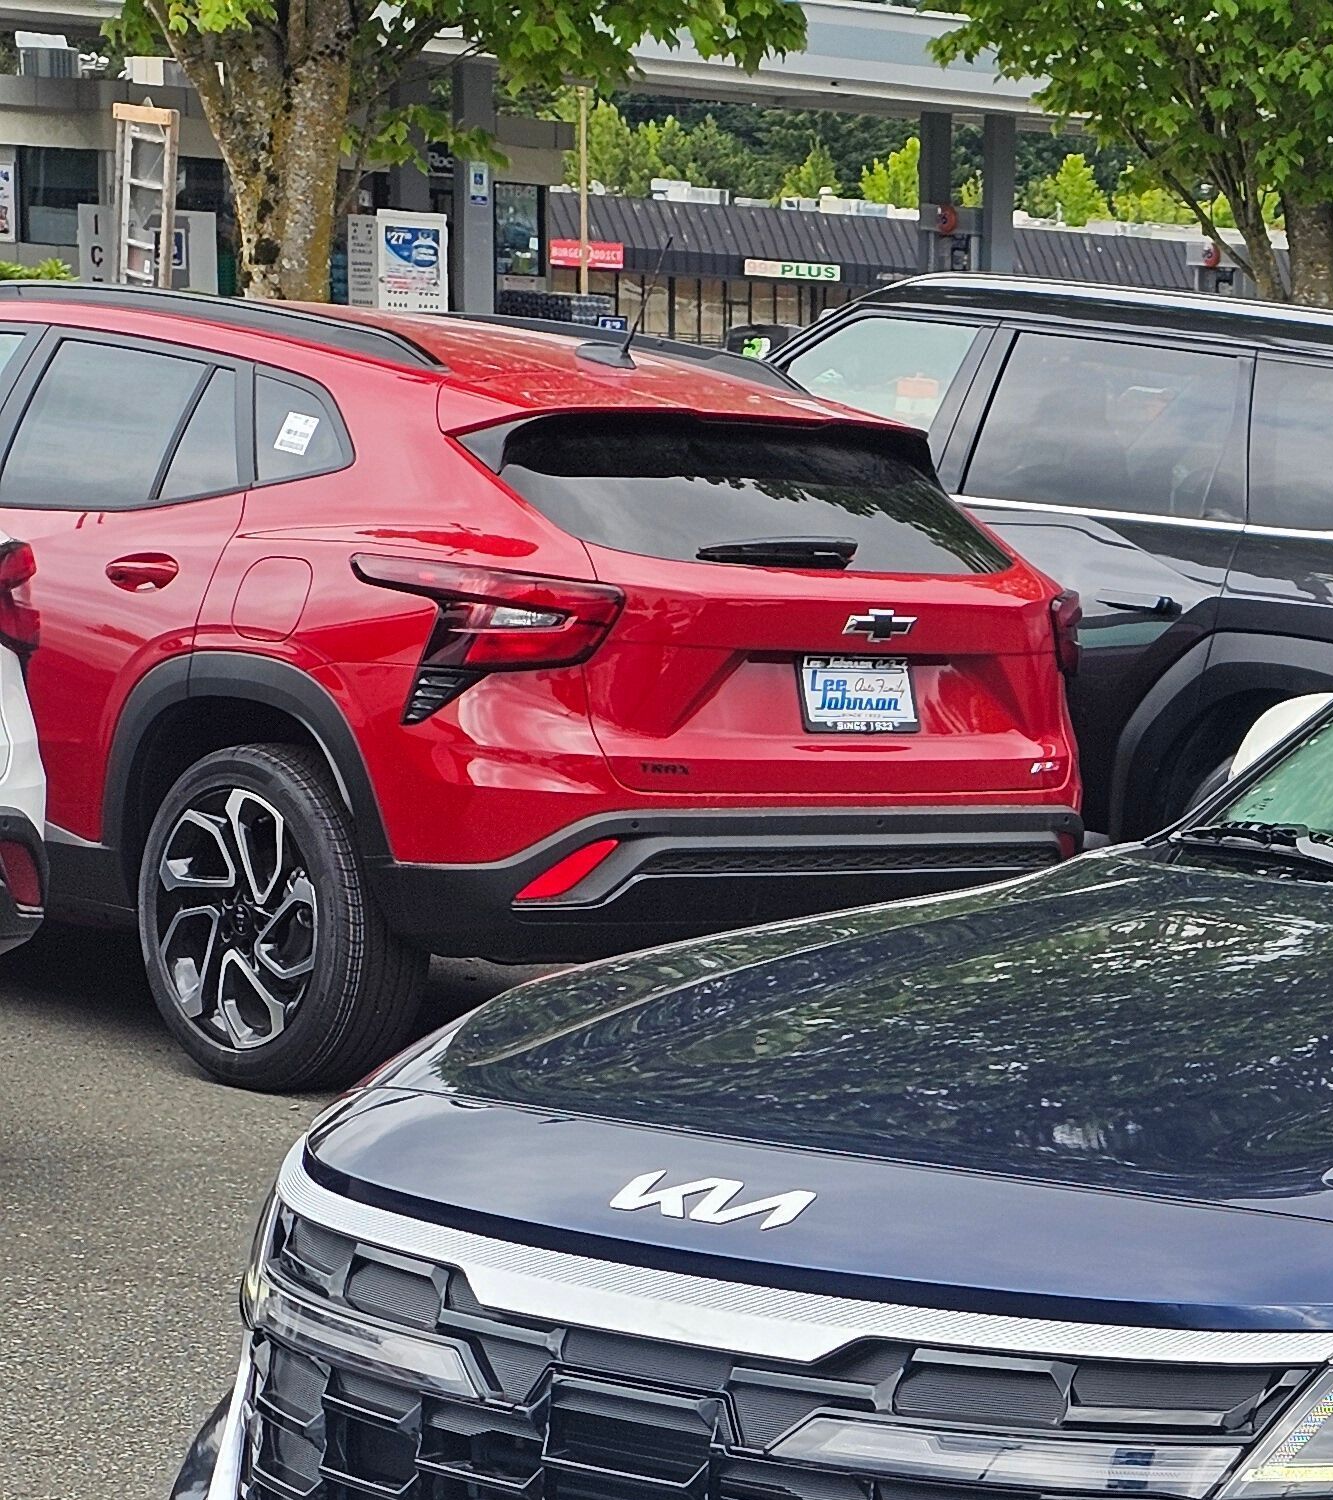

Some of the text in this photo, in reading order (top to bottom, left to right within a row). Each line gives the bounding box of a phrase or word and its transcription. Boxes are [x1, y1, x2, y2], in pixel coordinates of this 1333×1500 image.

[781, 263, 836, 279] PLUS
[811, 669, 850, 692] Lee
[815, 688, 902, 712] Johnson
[641, 763, 690, 775] TRAX
[609, 1169, 818, 1231] KIA
